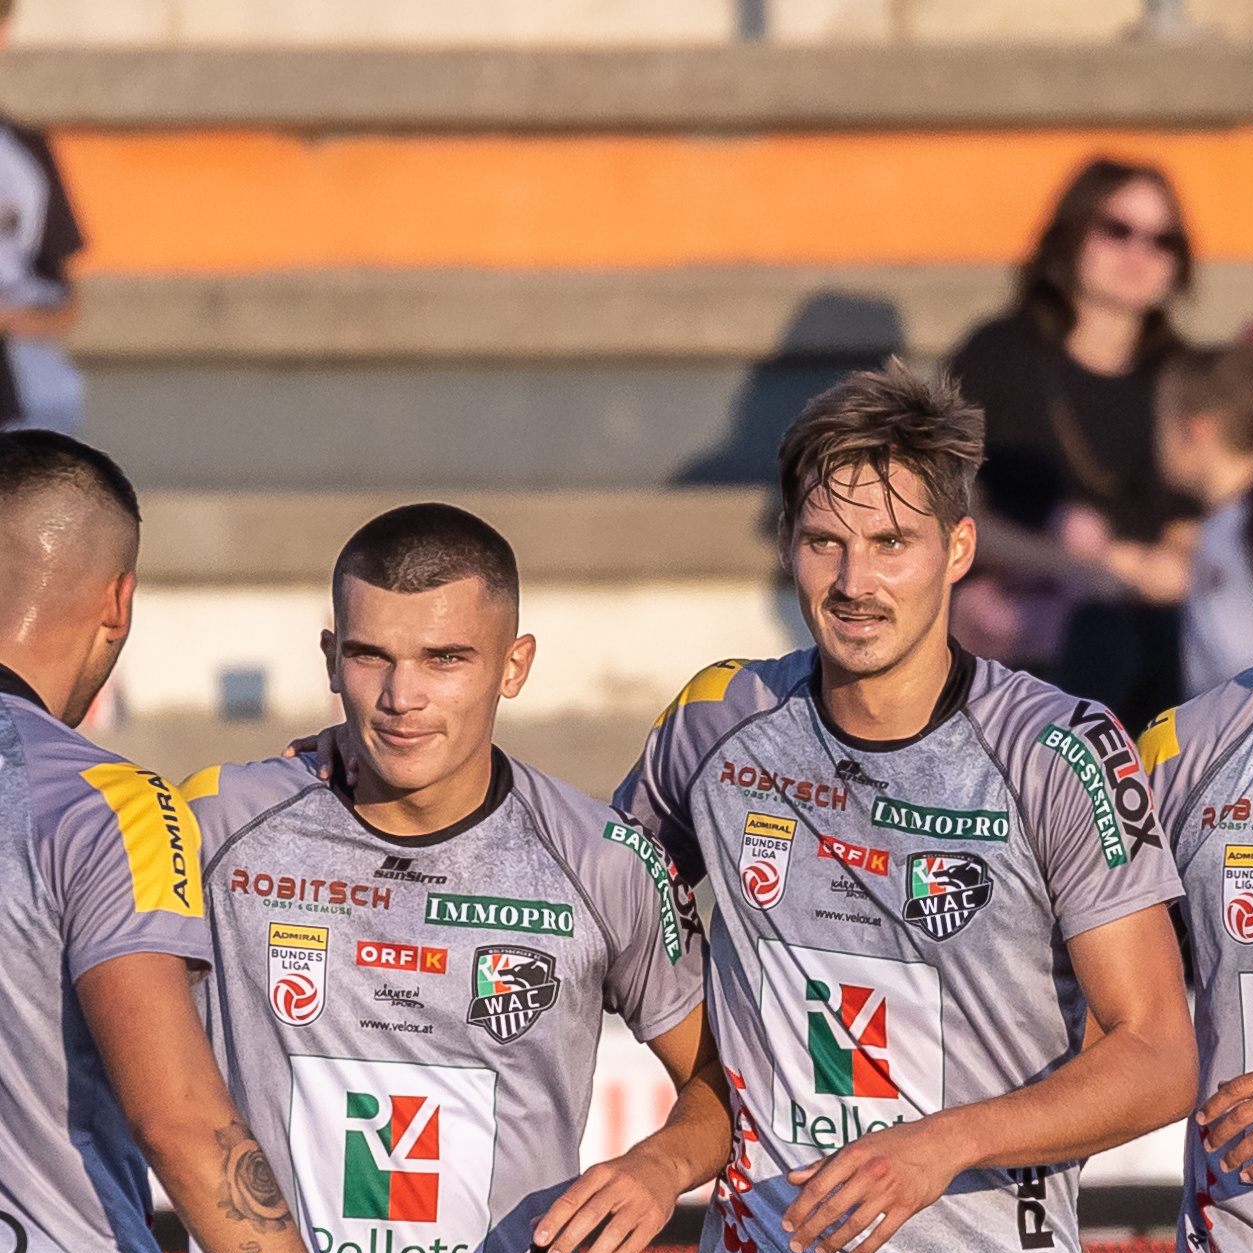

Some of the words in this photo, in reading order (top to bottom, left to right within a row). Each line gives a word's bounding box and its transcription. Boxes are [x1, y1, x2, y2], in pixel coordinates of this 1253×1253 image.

[1069, 700, 1163, 862] VELOX
[1045, 729, 1124, 861] BAU-SYSTEME
[747, 819, 792, 834] ADMIRAL
[874, 802, 1009, 837] IMMOPRO
[744, 837, 789, 851] BUNDES
[751, 850, 777, 860] LIGA
[871, 855, 886, 872] K
[231, 868, 392, 910] ROBITSCH
[919, 890, 976, 915] WAC
[427, 897, 573, 933] IMMOPRO
[815, 909, 882, 928] www.velox.at
[272, 930, 325, 944] ADMIRAL
[271, 948, 324, 962] BUNDES
[360, 945, 415, 966] ORF
[425, 952, 443, 969] K
[281, 961, 311, 971] LIGA
[484, 990, 540, 1015] WAC
[360, 1018, 434, 1035] www.velox.at
